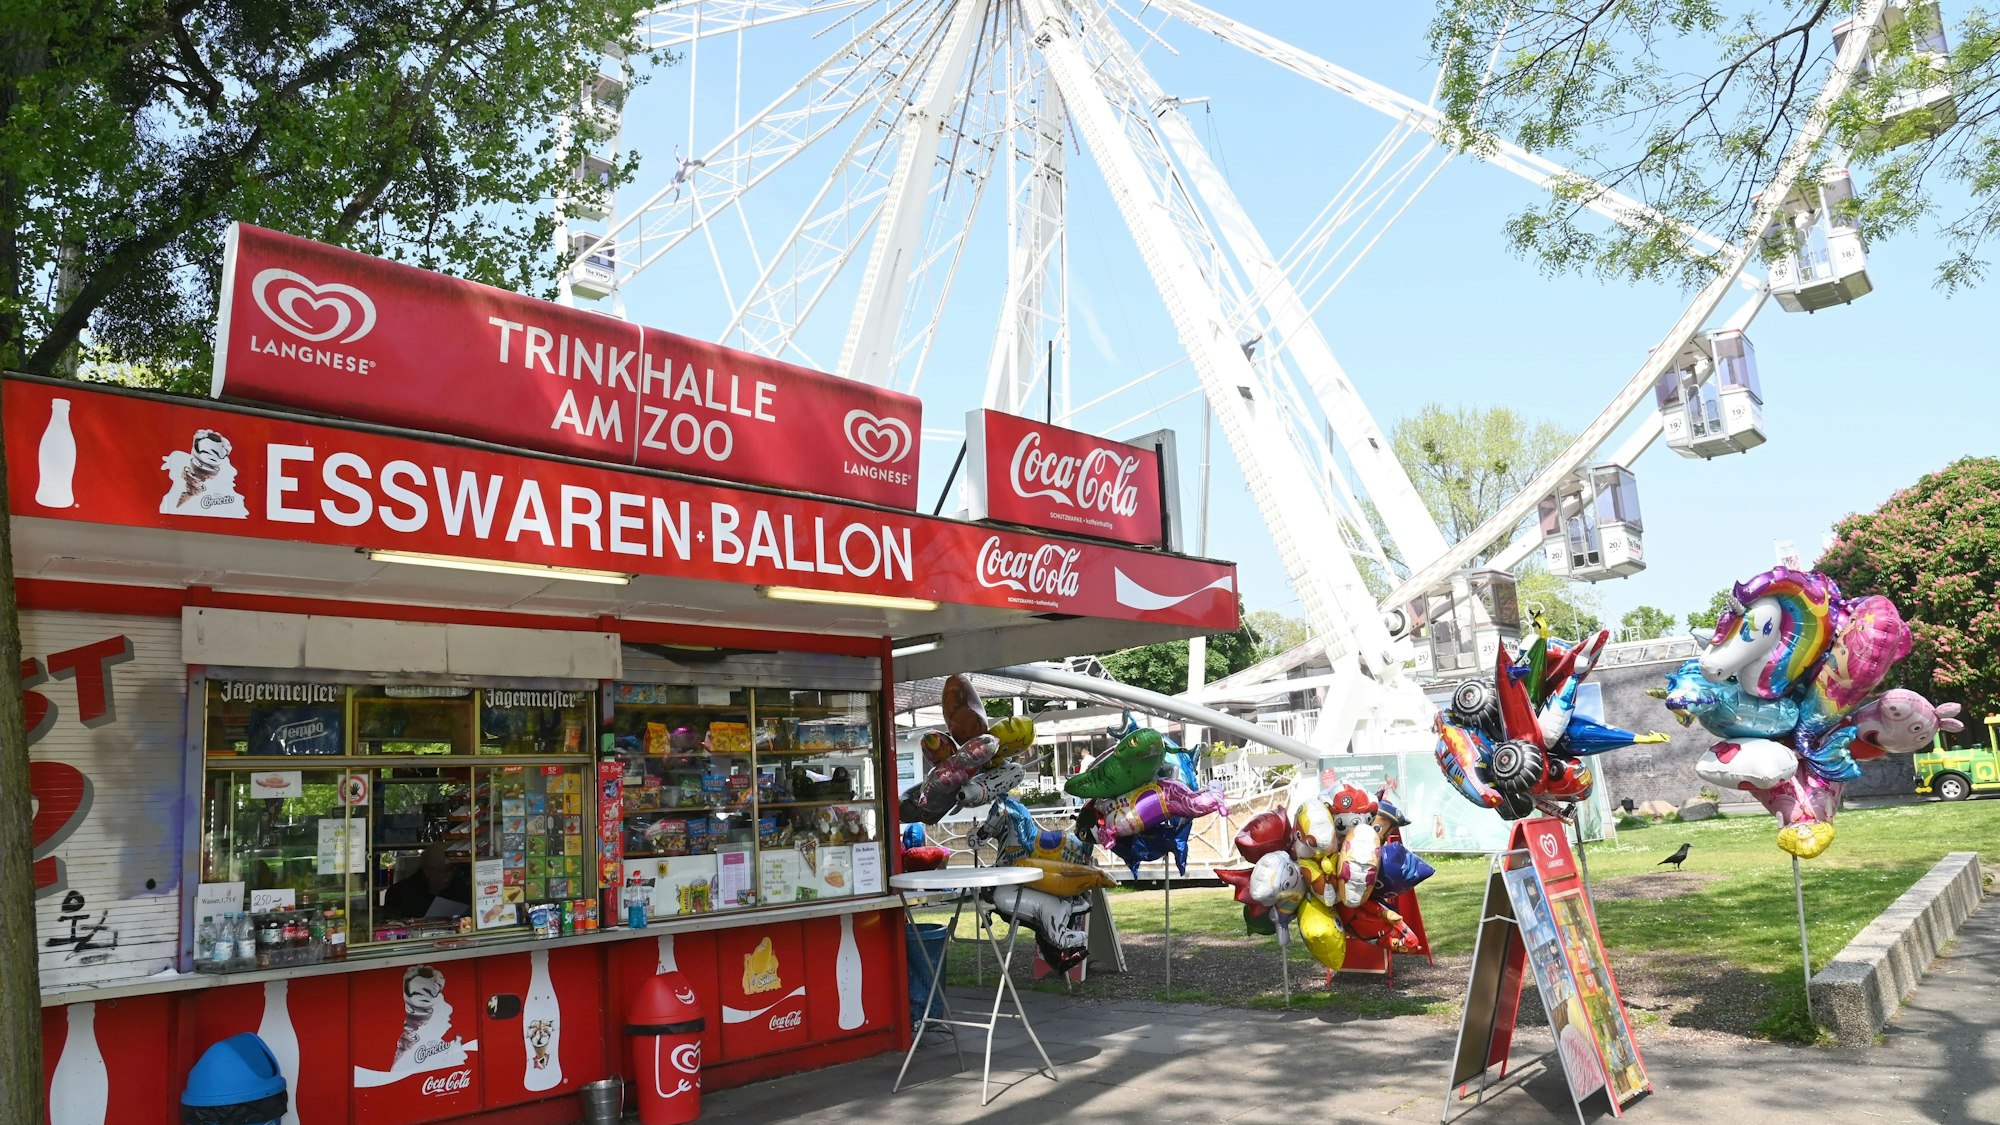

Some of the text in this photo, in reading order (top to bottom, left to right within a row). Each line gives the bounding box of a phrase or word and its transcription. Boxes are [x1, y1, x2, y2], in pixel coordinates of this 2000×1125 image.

[1841, 250, 1852, 259] 18
[1774, 268, 1784, 277] 18
[488, 316, 777, 423] TRINKHALLE
[1732, 408, 1741, 416] 19
[550, 388, 734, 462] AM ZOO
[1669, 422, 1678, 430] 19
[1009, 431, 1141, 518] Coca-Cola
[200, 494, 235, 510] Cornetto
[1049, 511, 1083, 524] SCHUTZMARKE
[1608, 542, 1618, 550] 20
[1551, 552, 1560, 560] 20
[975, 535, 1082, 597] Coca-Cola
[279, 721, 324, 741] Tempo
[413, 1041, 451, 1064] Cornetto
